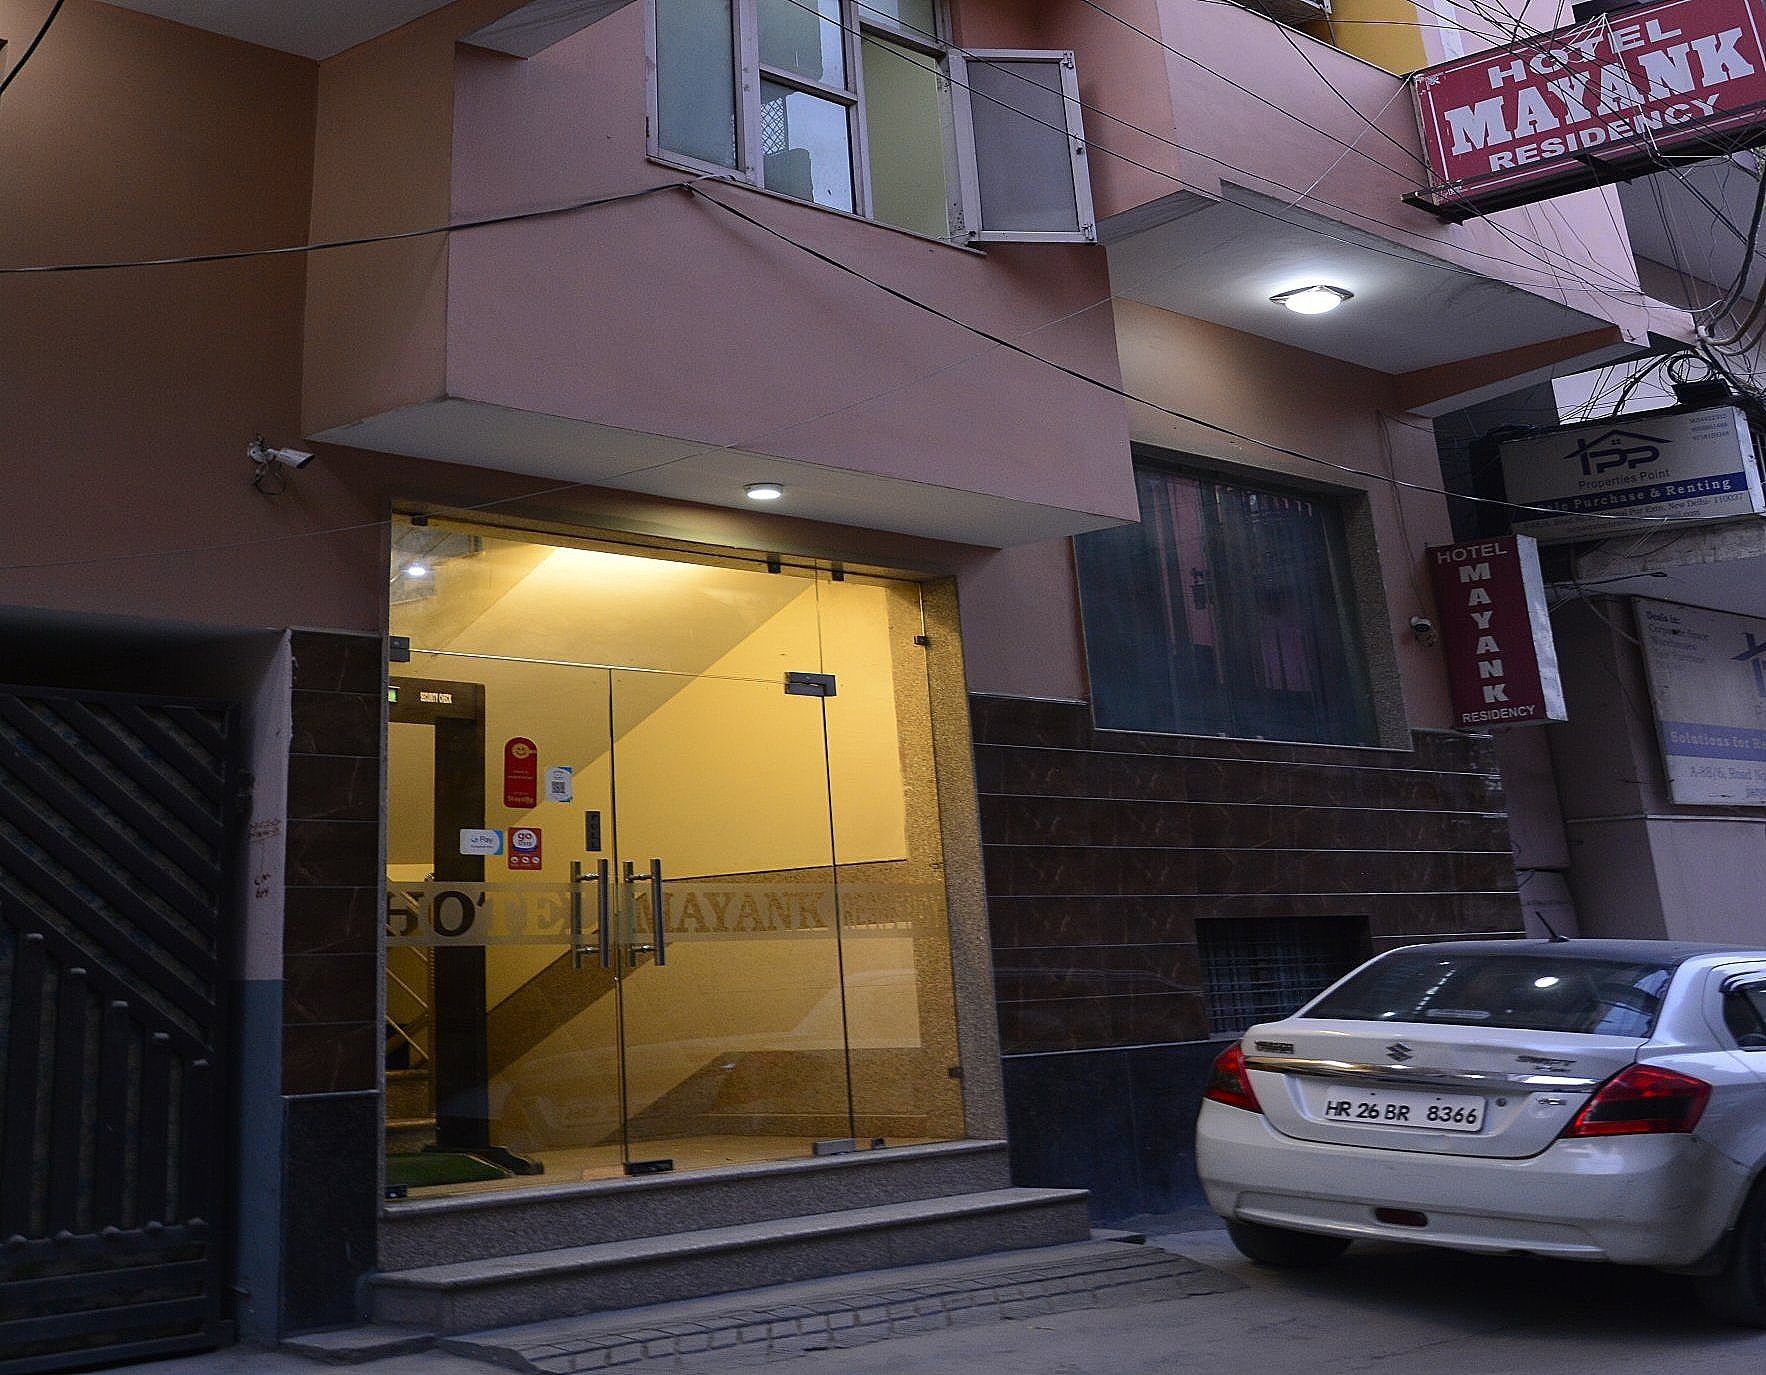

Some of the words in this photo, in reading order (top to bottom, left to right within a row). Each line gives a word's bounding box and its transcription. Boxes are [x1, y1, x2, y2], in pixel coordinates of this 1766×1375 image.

[1487, 18, 1683, 89] HOTEL
[1444, 27, 1756, 156] MAYANK
[1489, 94, 1721, 173] RESIDENCY
[1573, 489, 1645, 510] Purchase
[1649, 487, 1664, 498] &
[1665, 478, 1733, 497] Renting
[1578, 475, 1637, 490] Properties
[1640, 469, 1671, 483] Point
[1437, 542, 1509, 564] HOTEL
[1458, 562, 1510, 704] MAYANK
[1461, 704, 1537, 723] RESIDENCY
[634, 889, 829, 934] MAYANK
[1325, 1101, 1351, 1118] HR
[1356, 1103, 1380, 1120] 26
[1384, 1105, 1410, 1122] BR
[1427, 1105, 1478, 1125] 8366
